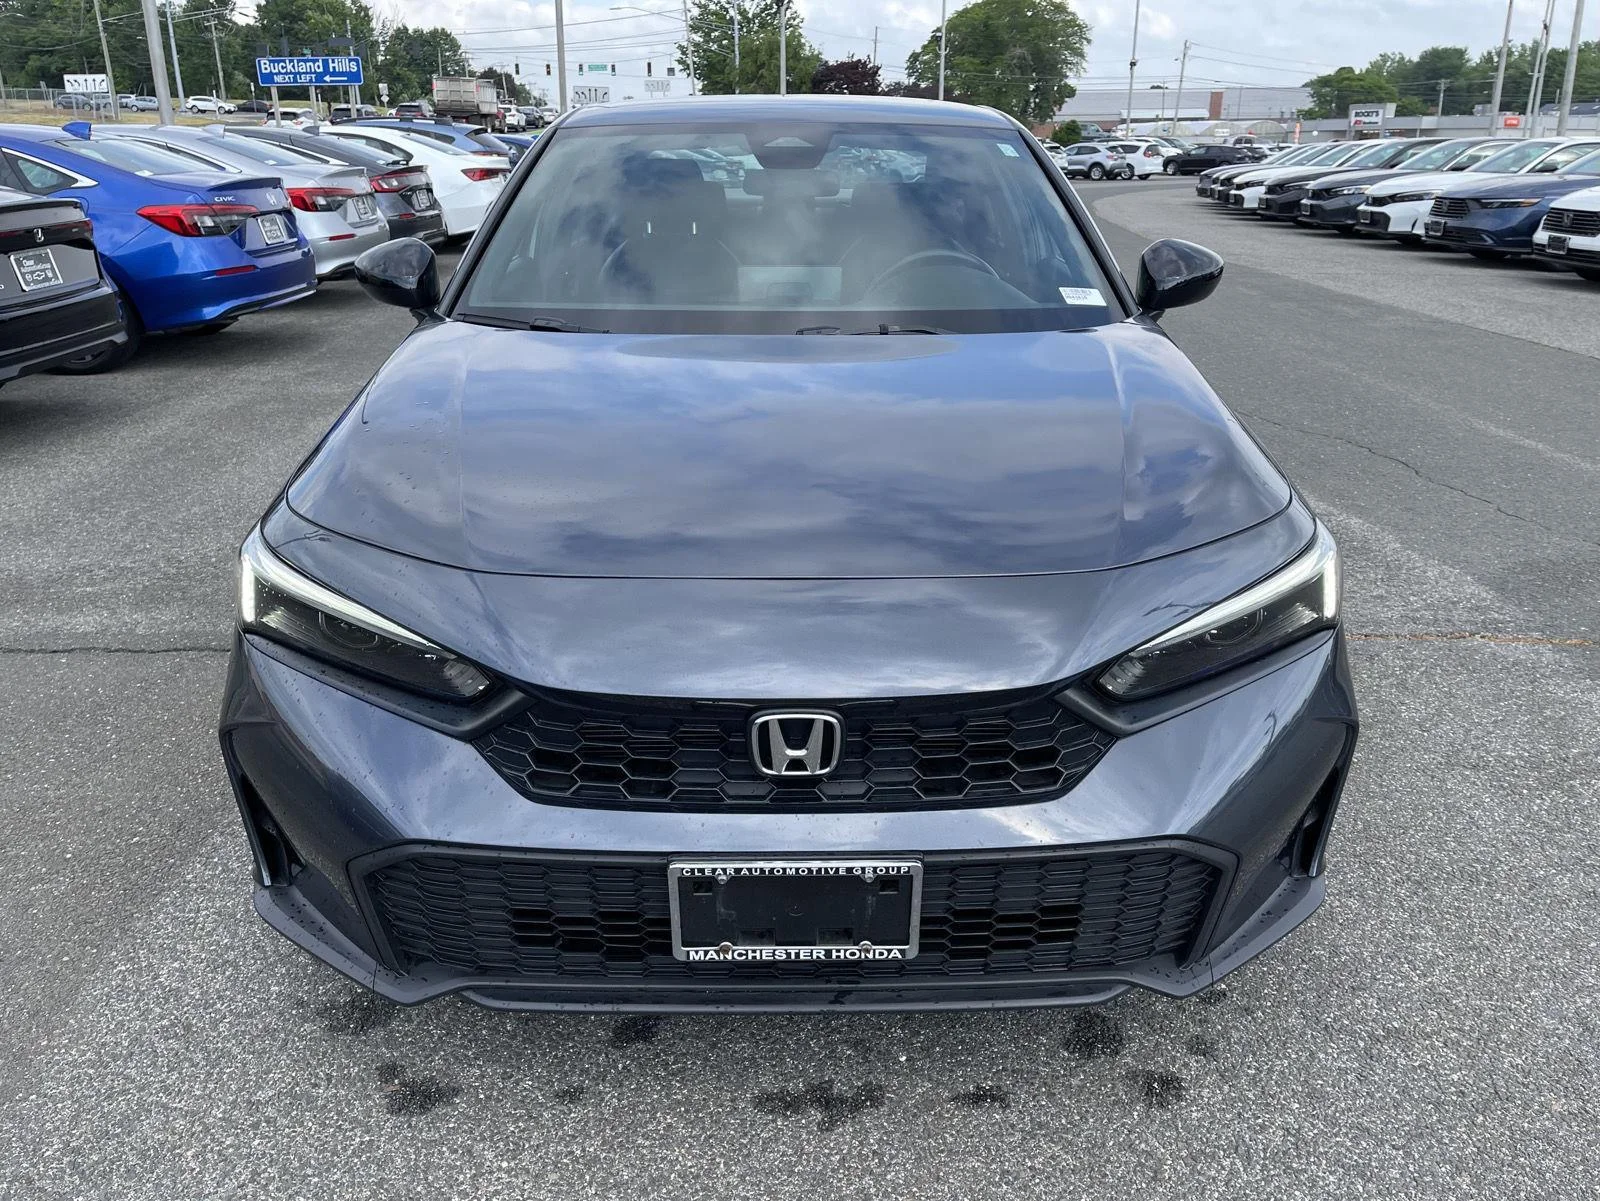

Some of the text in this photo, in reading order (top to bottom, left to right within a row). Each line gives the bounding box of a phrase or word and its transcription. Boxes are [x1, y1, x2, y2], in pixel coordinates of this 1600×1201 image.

[260, 58, 358, 73] Buckland Hills
[273, 74, 316, 83] NEXT LEFT
[682, 866, 909, 876] CLEAR AUTOMOTIVE GROUP
[689, 949, 902, 961] MANCHESTER HONDA
